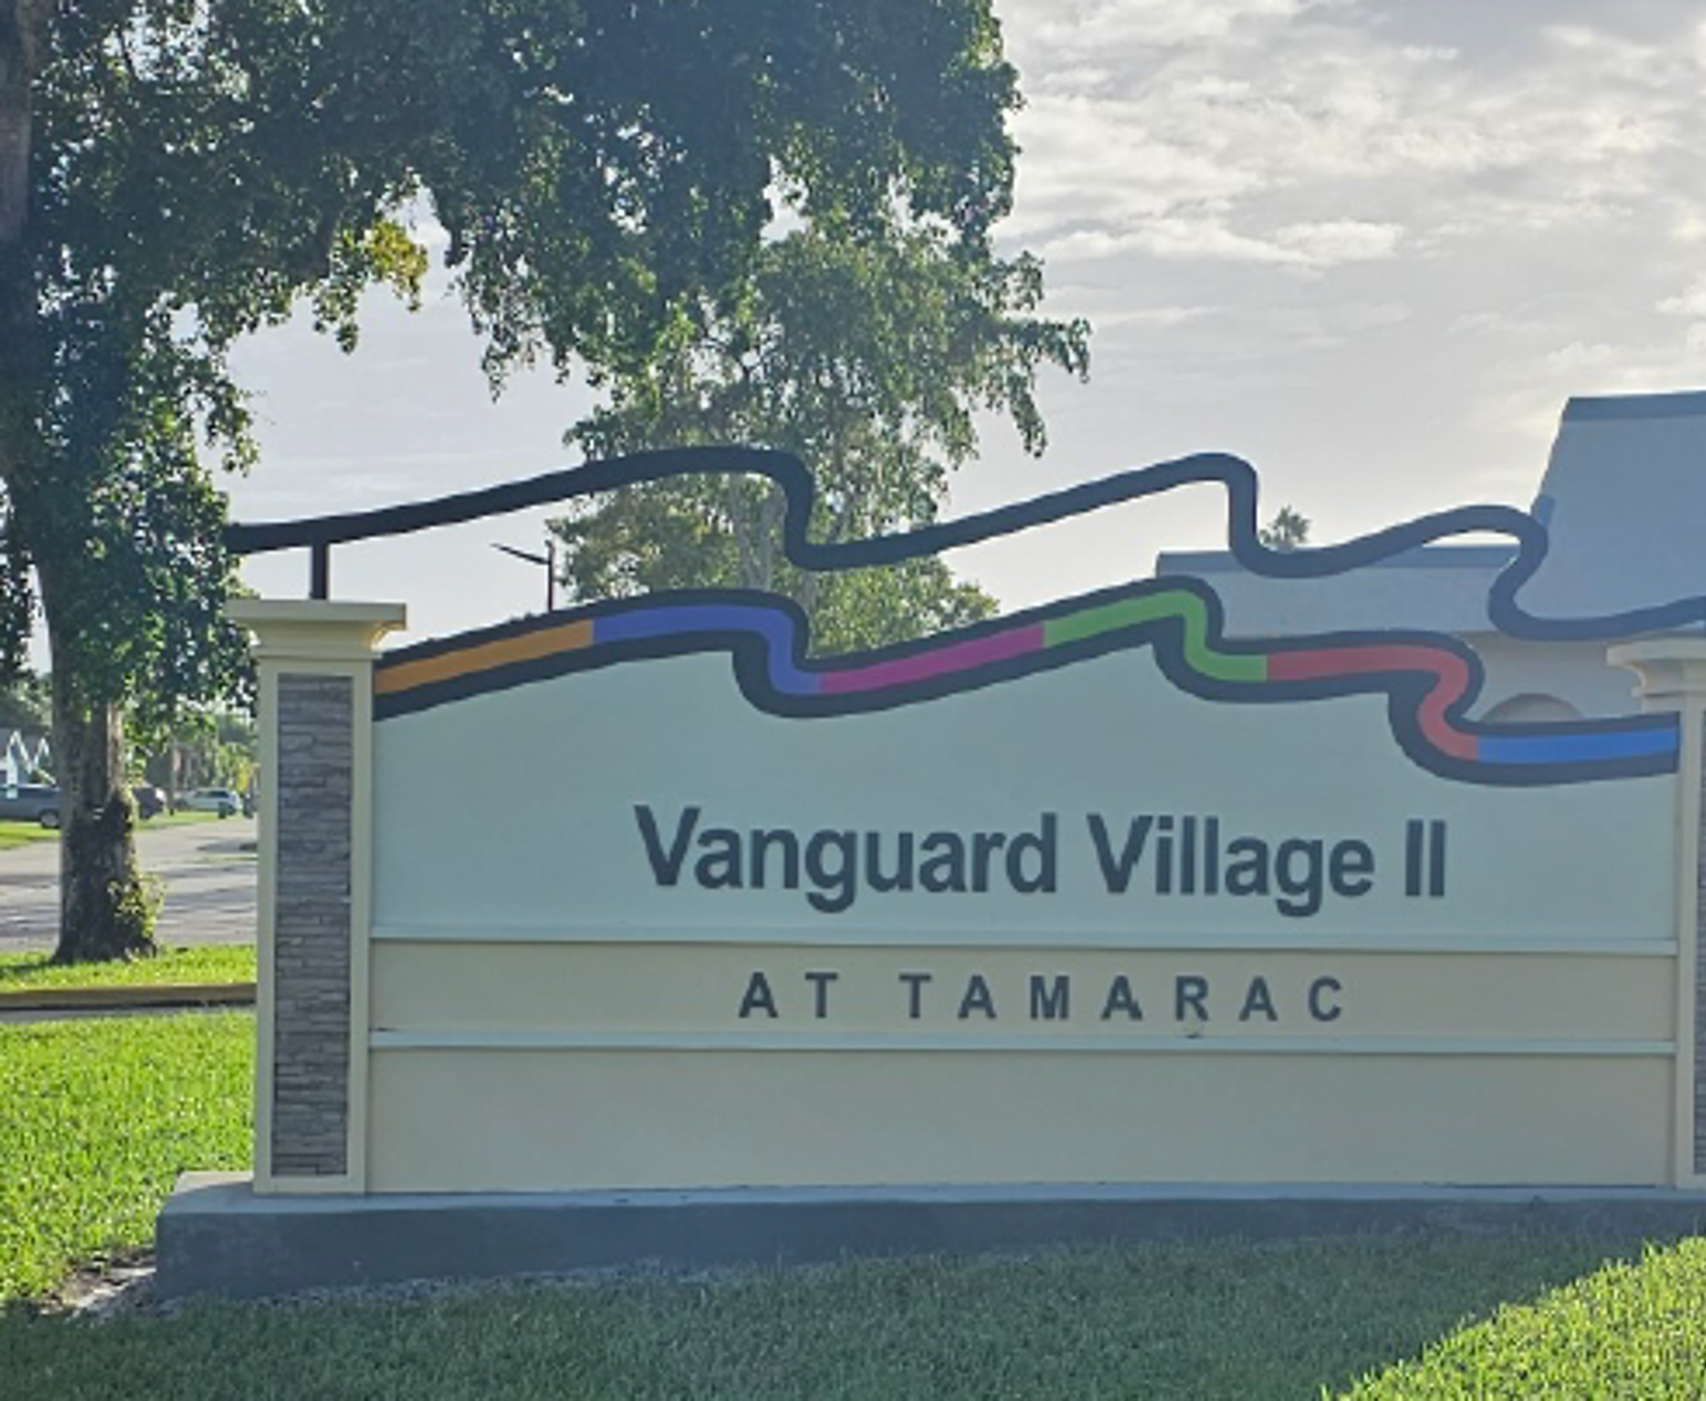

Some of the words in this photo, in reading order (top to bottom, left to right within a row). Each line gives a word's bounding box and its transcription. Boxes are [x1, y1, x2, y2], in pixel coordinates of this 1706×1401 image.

[633, 804, 1059, 914] Vanguard
[1086, 813, 1376, 919] Village
[1404, 819, 1448, 898] II
[738, 971, 839, 1020] AT
[899, 973, 1344, 1023] TAMARAC
